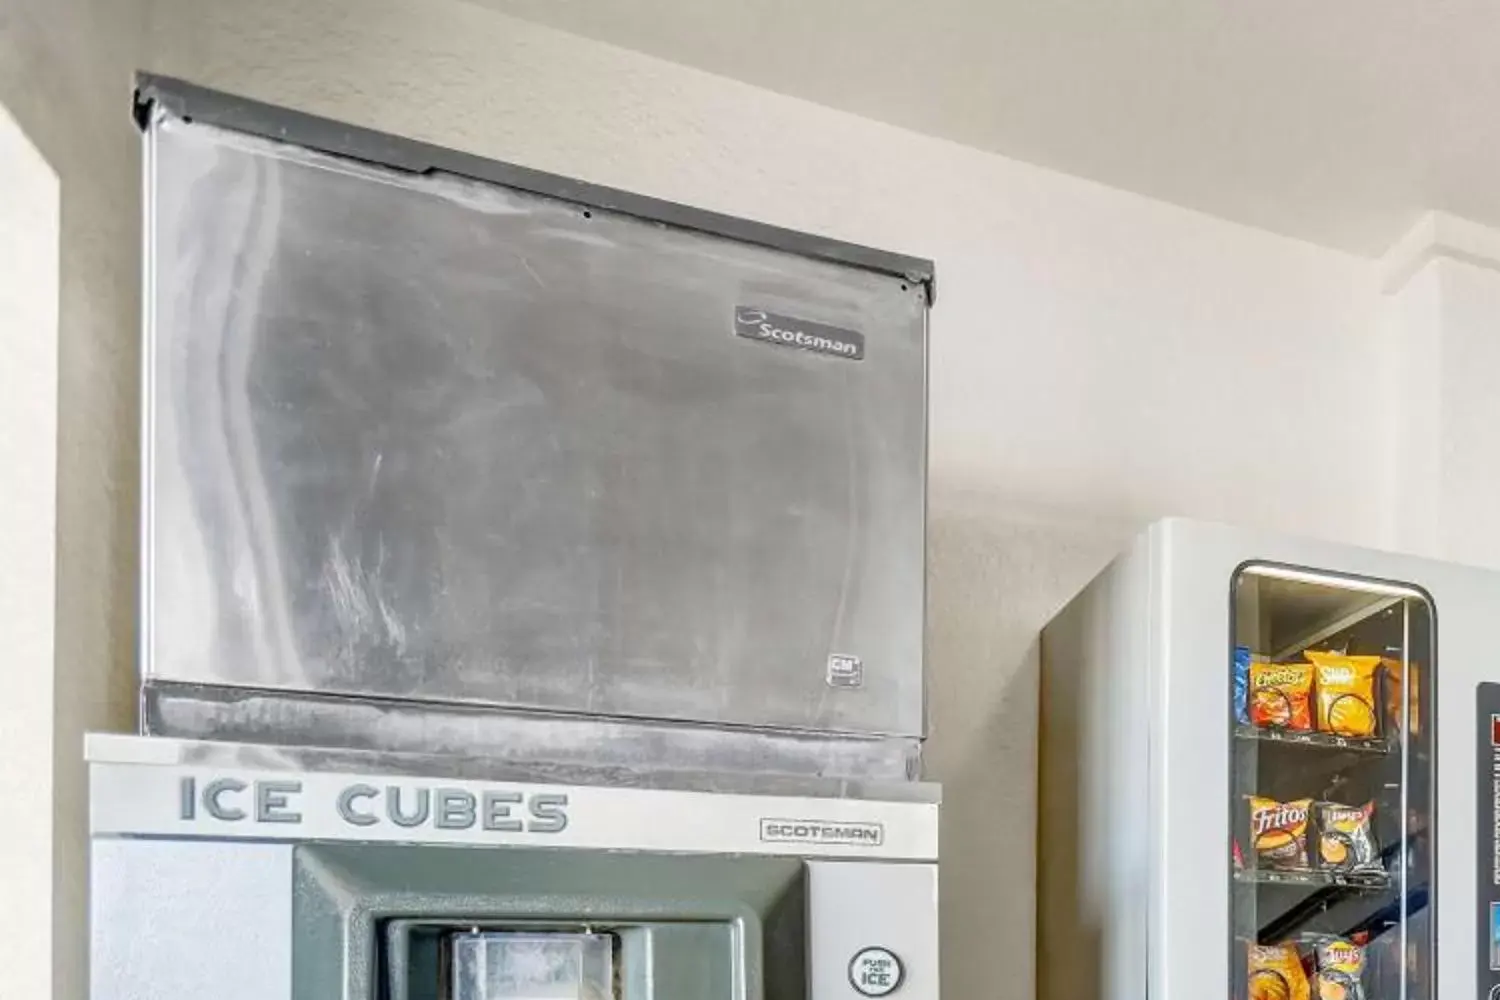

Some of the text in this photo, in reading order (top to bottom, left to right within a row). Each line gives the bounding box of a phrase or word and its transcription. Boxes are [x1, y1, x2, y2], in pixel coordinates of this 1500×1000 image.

[759, 322, 857, 355] Scotsman
[180, 776, 569, 833] ICE CUBES
[766, 824, 878, 840] SCOTSMAN
[1253, 806, 1307, 834] Fritos
[862, 972, 891, 987] ICE
